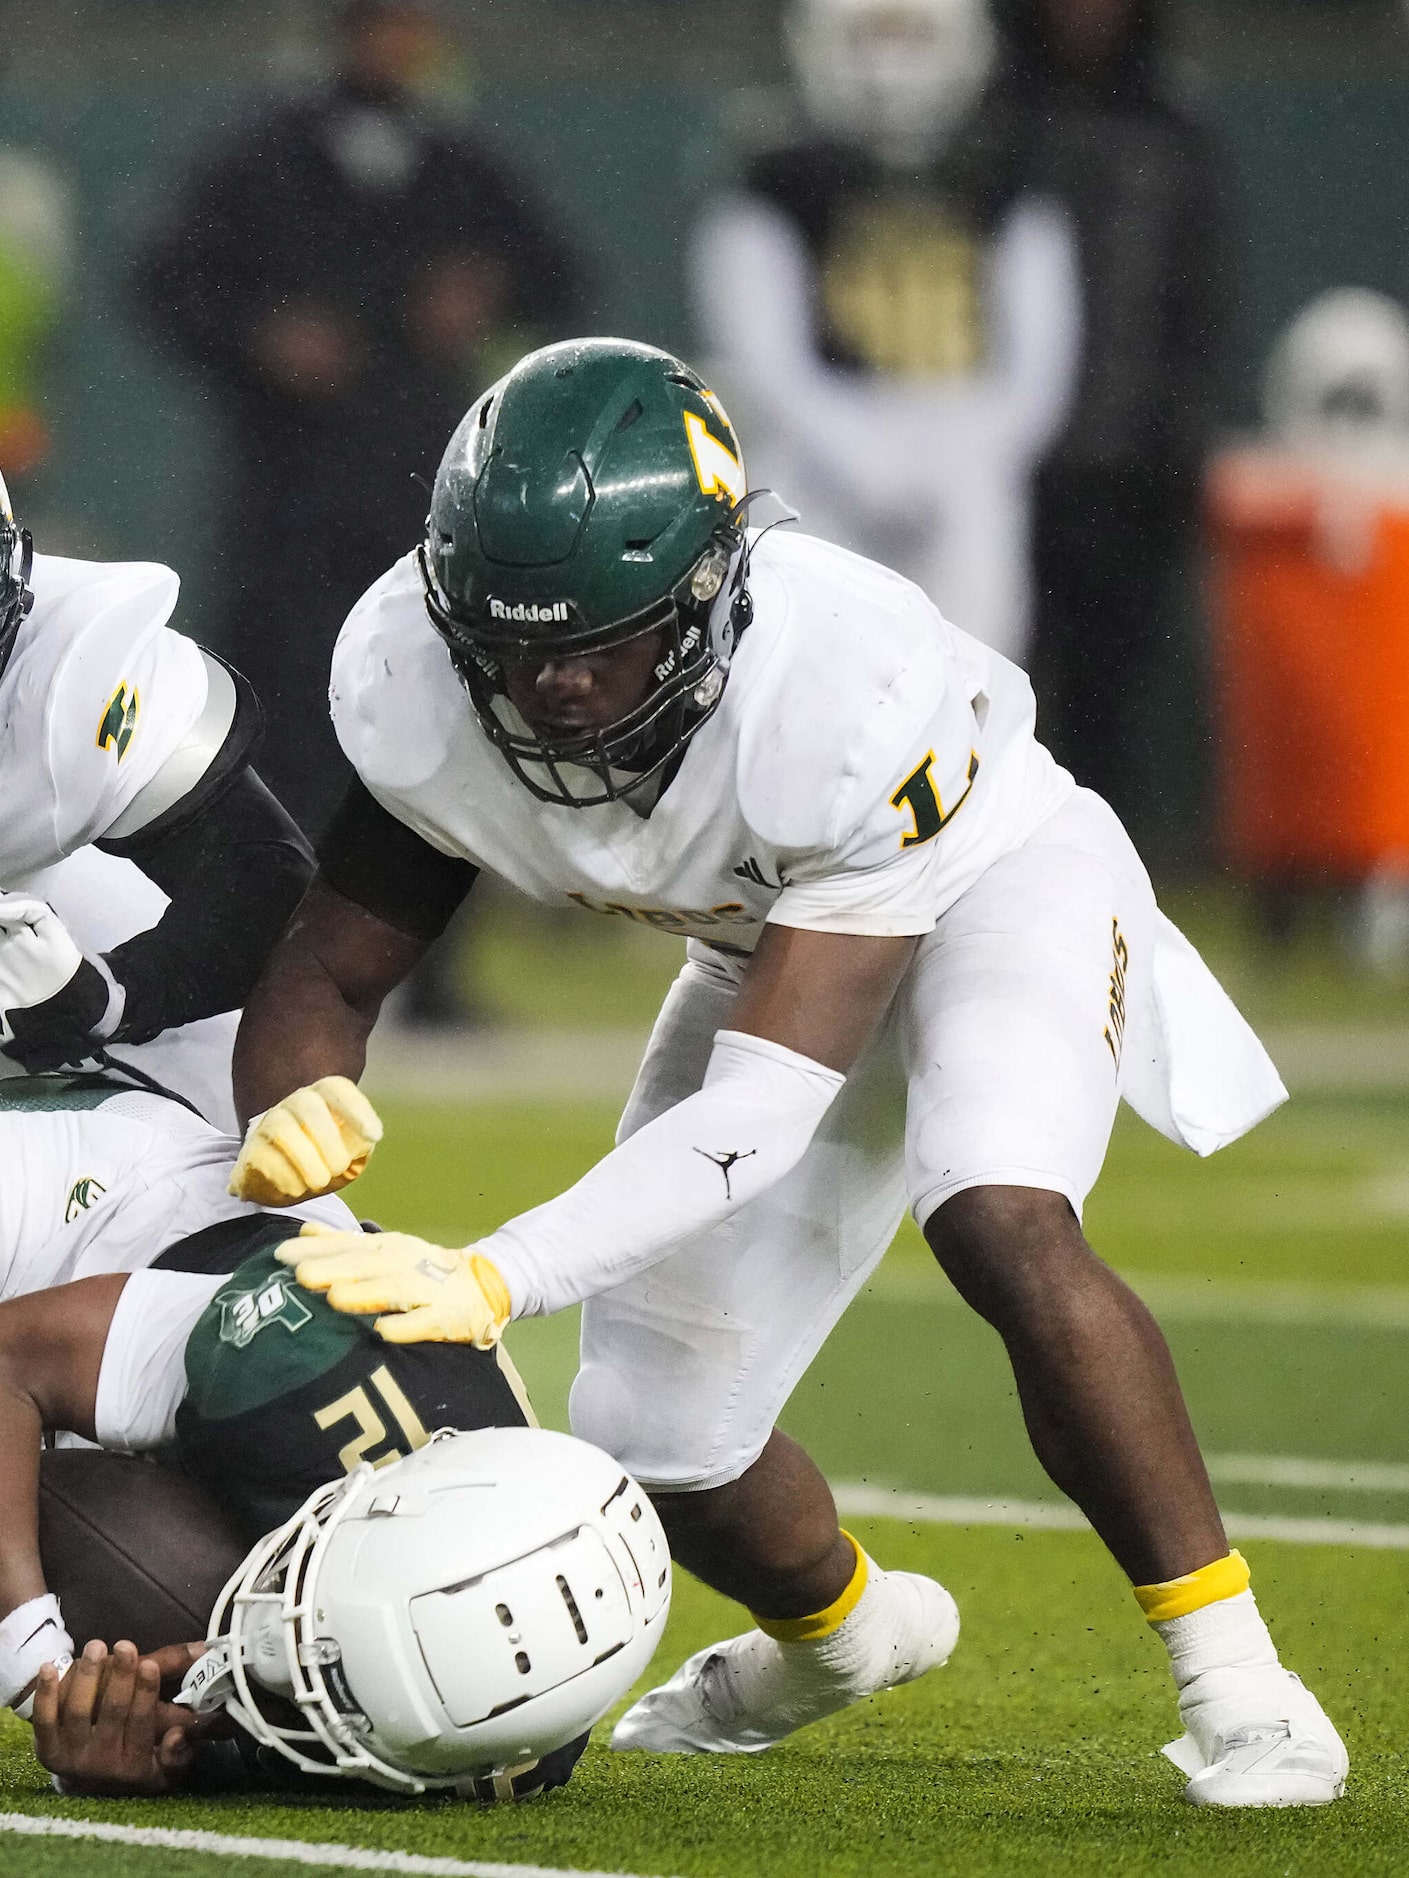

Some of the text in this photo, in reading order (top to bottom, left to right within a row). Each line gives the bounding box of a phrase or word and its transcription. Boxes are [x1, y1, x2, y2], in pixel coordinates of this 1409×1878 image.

[486, 598, 568, 623] Riddell
[888, 747, 981, 851] L
[314, 1364, 432, 1476] 12
